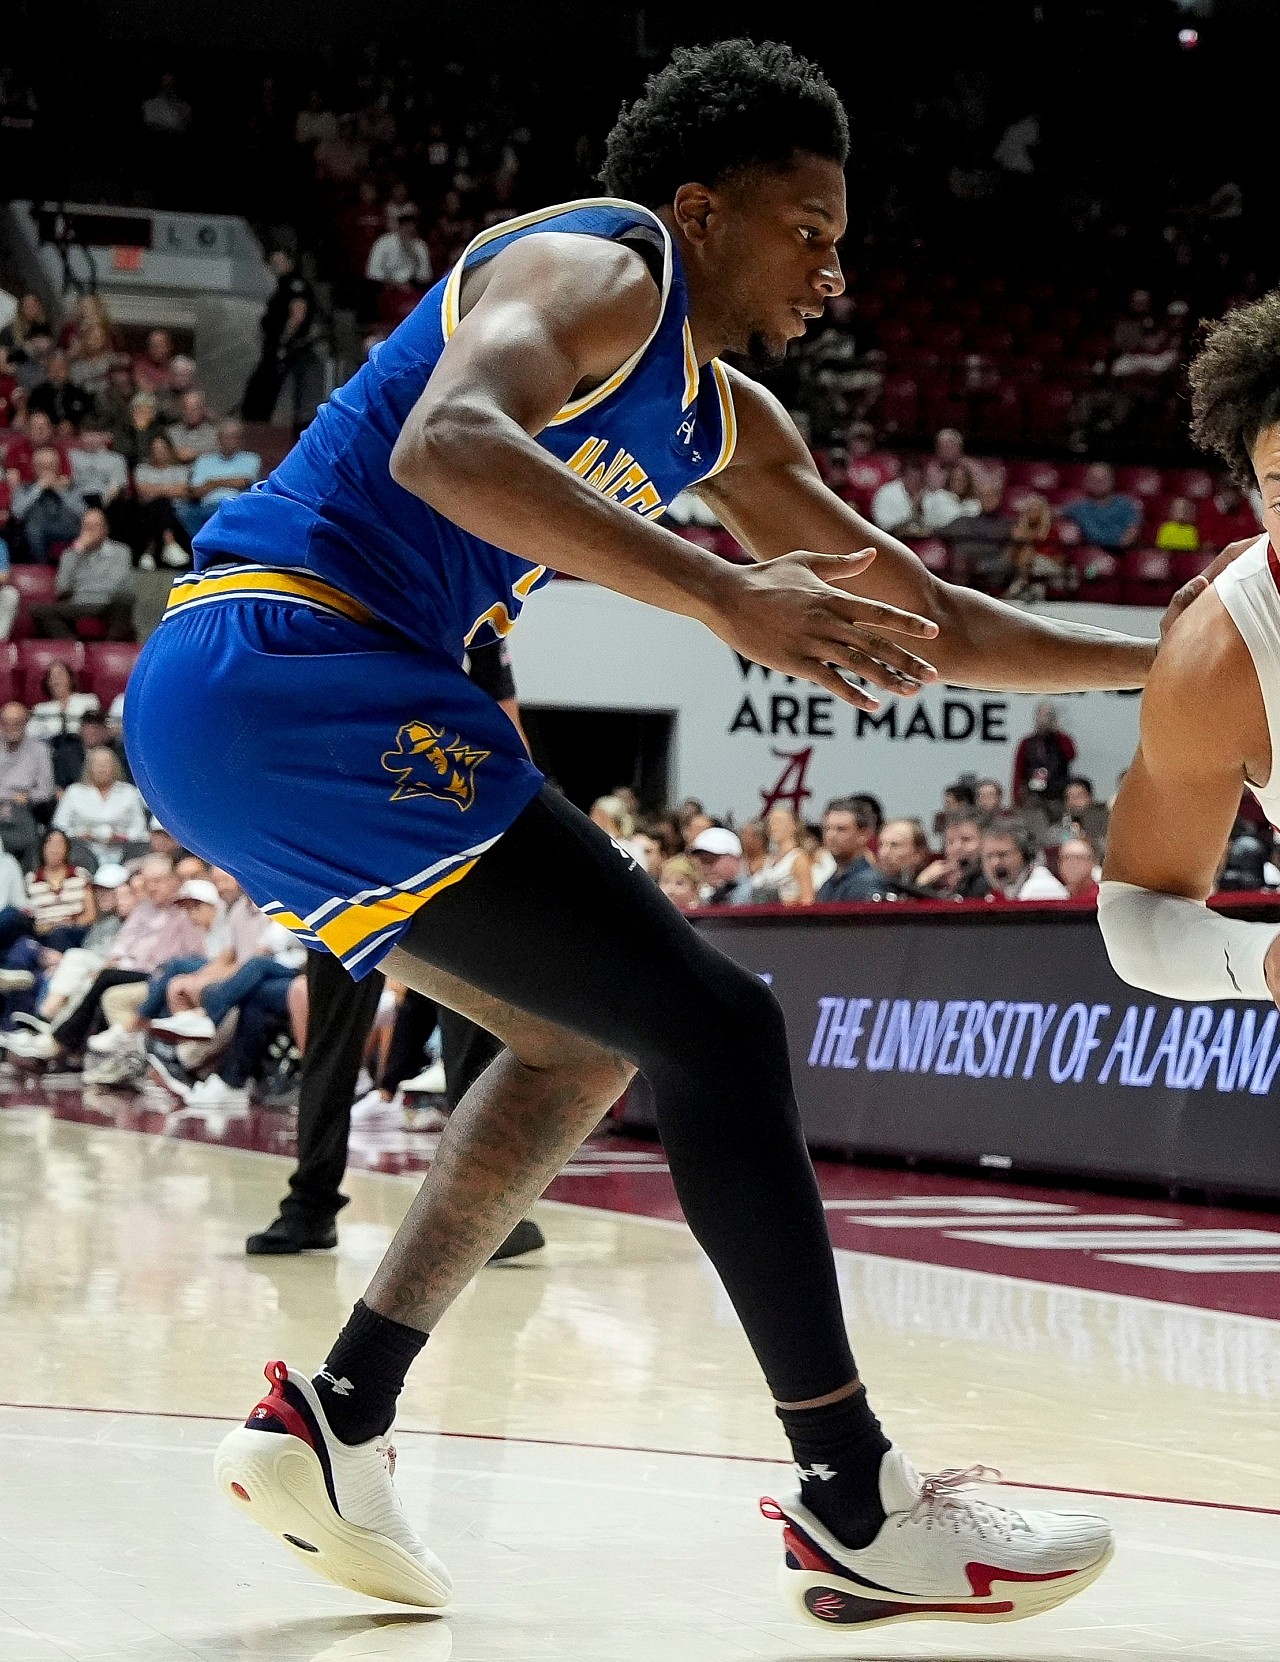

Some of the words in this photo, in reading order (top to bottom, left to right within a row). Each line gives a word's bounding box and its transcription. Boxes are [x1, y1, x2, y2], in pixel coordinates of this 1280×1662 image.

[730, 694, 834, 736] ARE
[855, 700, 1008, 742] MADE
[807, 996, 873, 1068] THE
[866, 999, 1057, 1080] UNIVERSITY
[1050, 1002, 1111, 1083] OF
